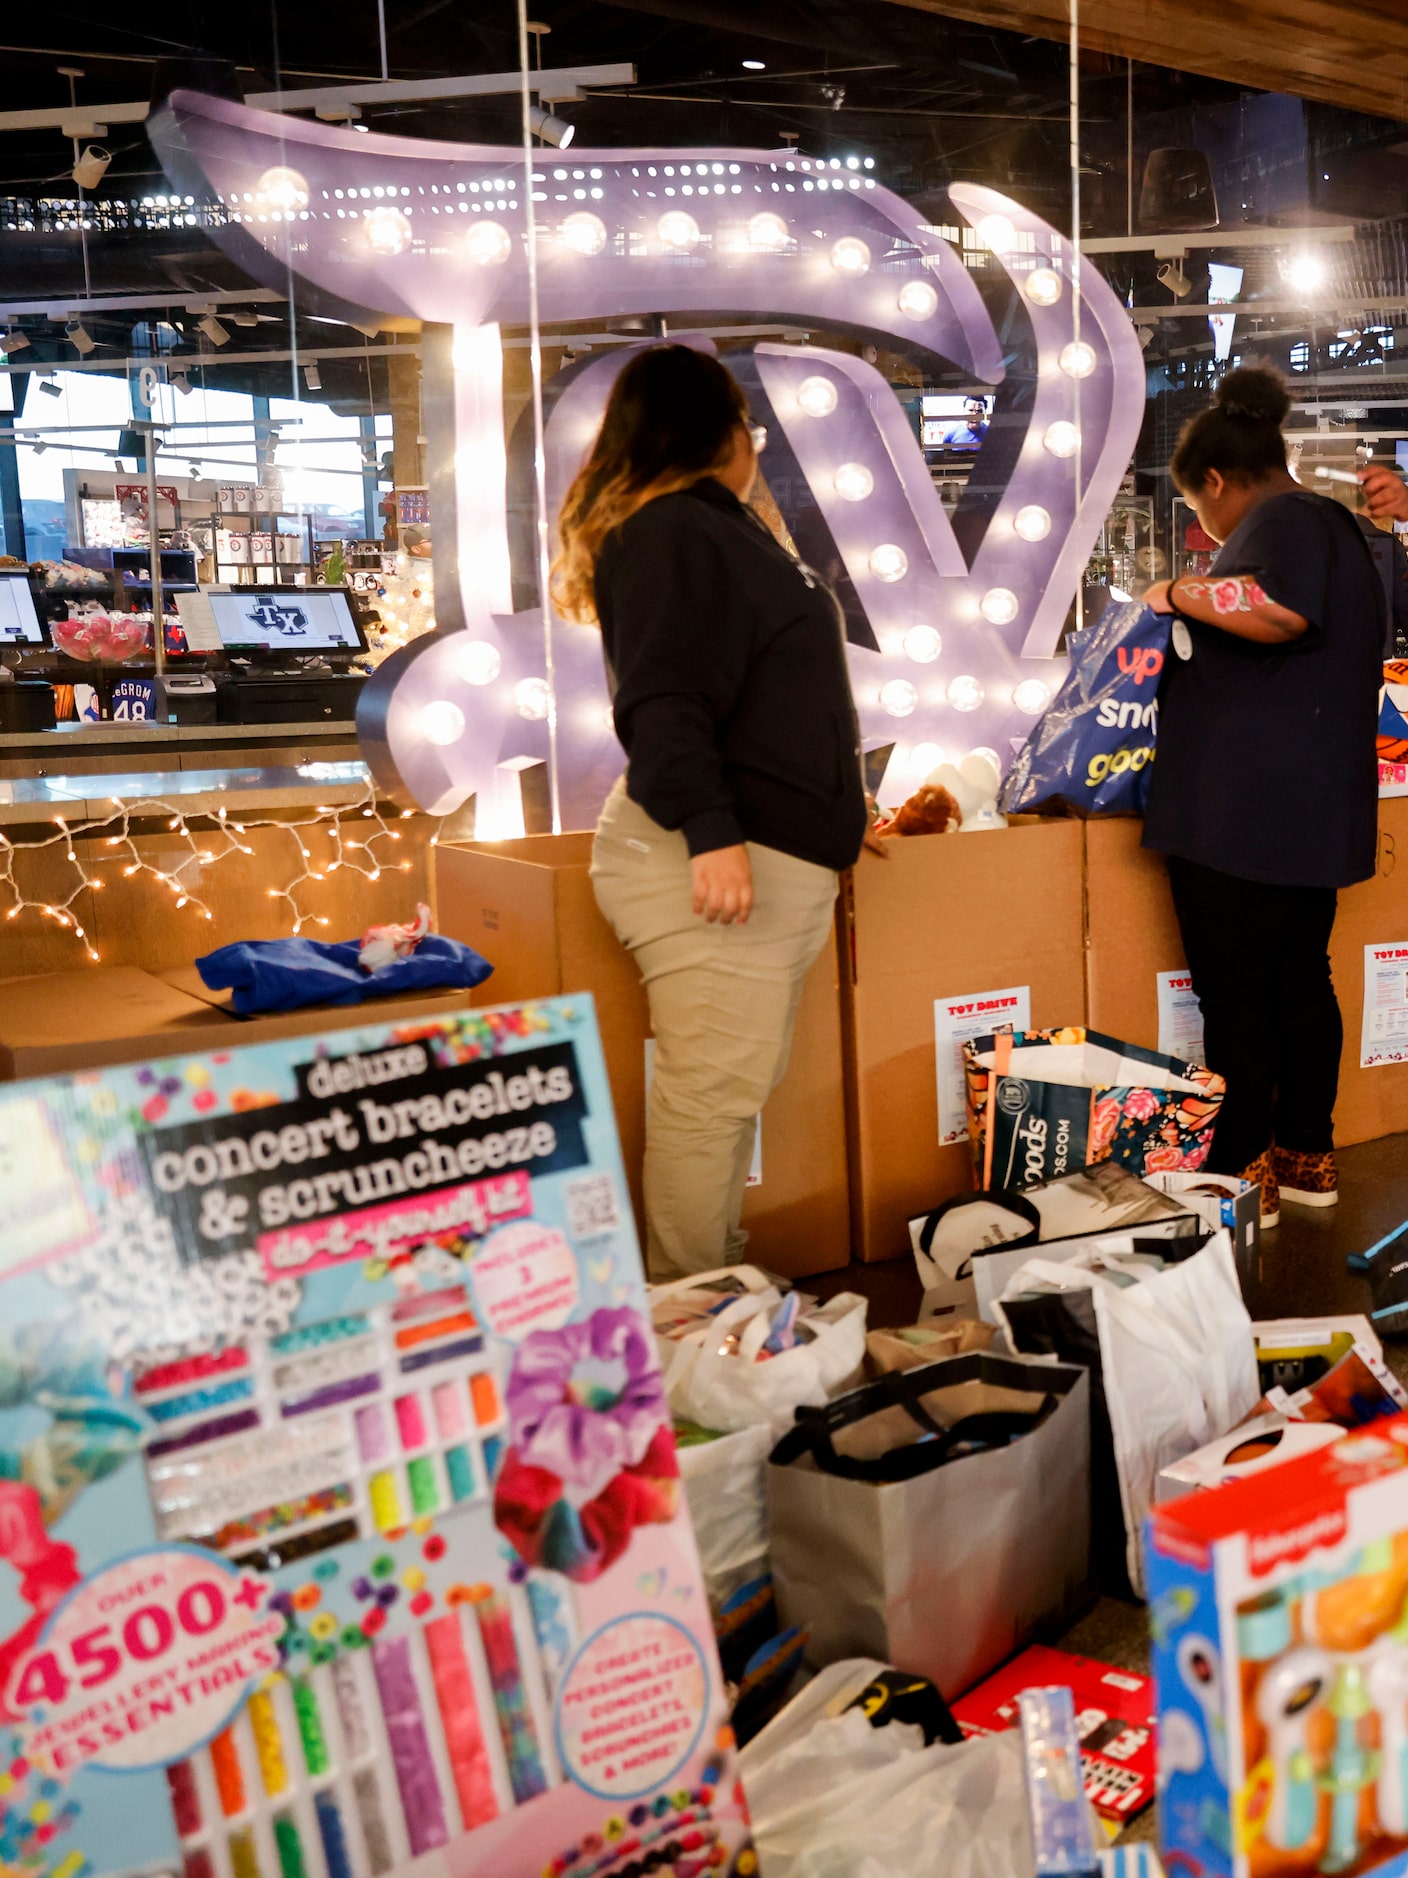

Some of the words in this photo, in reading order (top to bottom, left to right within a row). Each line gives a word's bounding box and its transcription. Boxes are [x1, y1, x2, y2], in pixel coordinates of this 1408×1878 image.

[1117, 646, 1164, 686] up
[112, 682, 151, 700] eGROM
[113, 701, 146, 721] 48
[1085, 746, 1156, 787] goo
[1374, 950, 1393, 960] TOY
[947, 1003, 974, 1016] TOY
[976, 996, 1018, 1011] DRIVE
[308, 1042, 428, 1100] deluxe
[152, 1108, 360, 1193] concert
[359, 1064, 574, 1145] bracelets
[199, 1189, 249, 1240] &
[97, 1572, 168, 1612] OVER
[14, 1576, 268, 1705] 4500+
[594, 1642, 661, 1675] CREATE
[563, 1652, 696, 1706] PERSONALIZED
[590, 1679, 673, 1720] CONCERT
[52, 1648, 274, 1770] ESSENTIALS
[581, 1698, 683, 1745] BRACELETS
[580, 1716, 692, 1767] SCRUNCHIES
